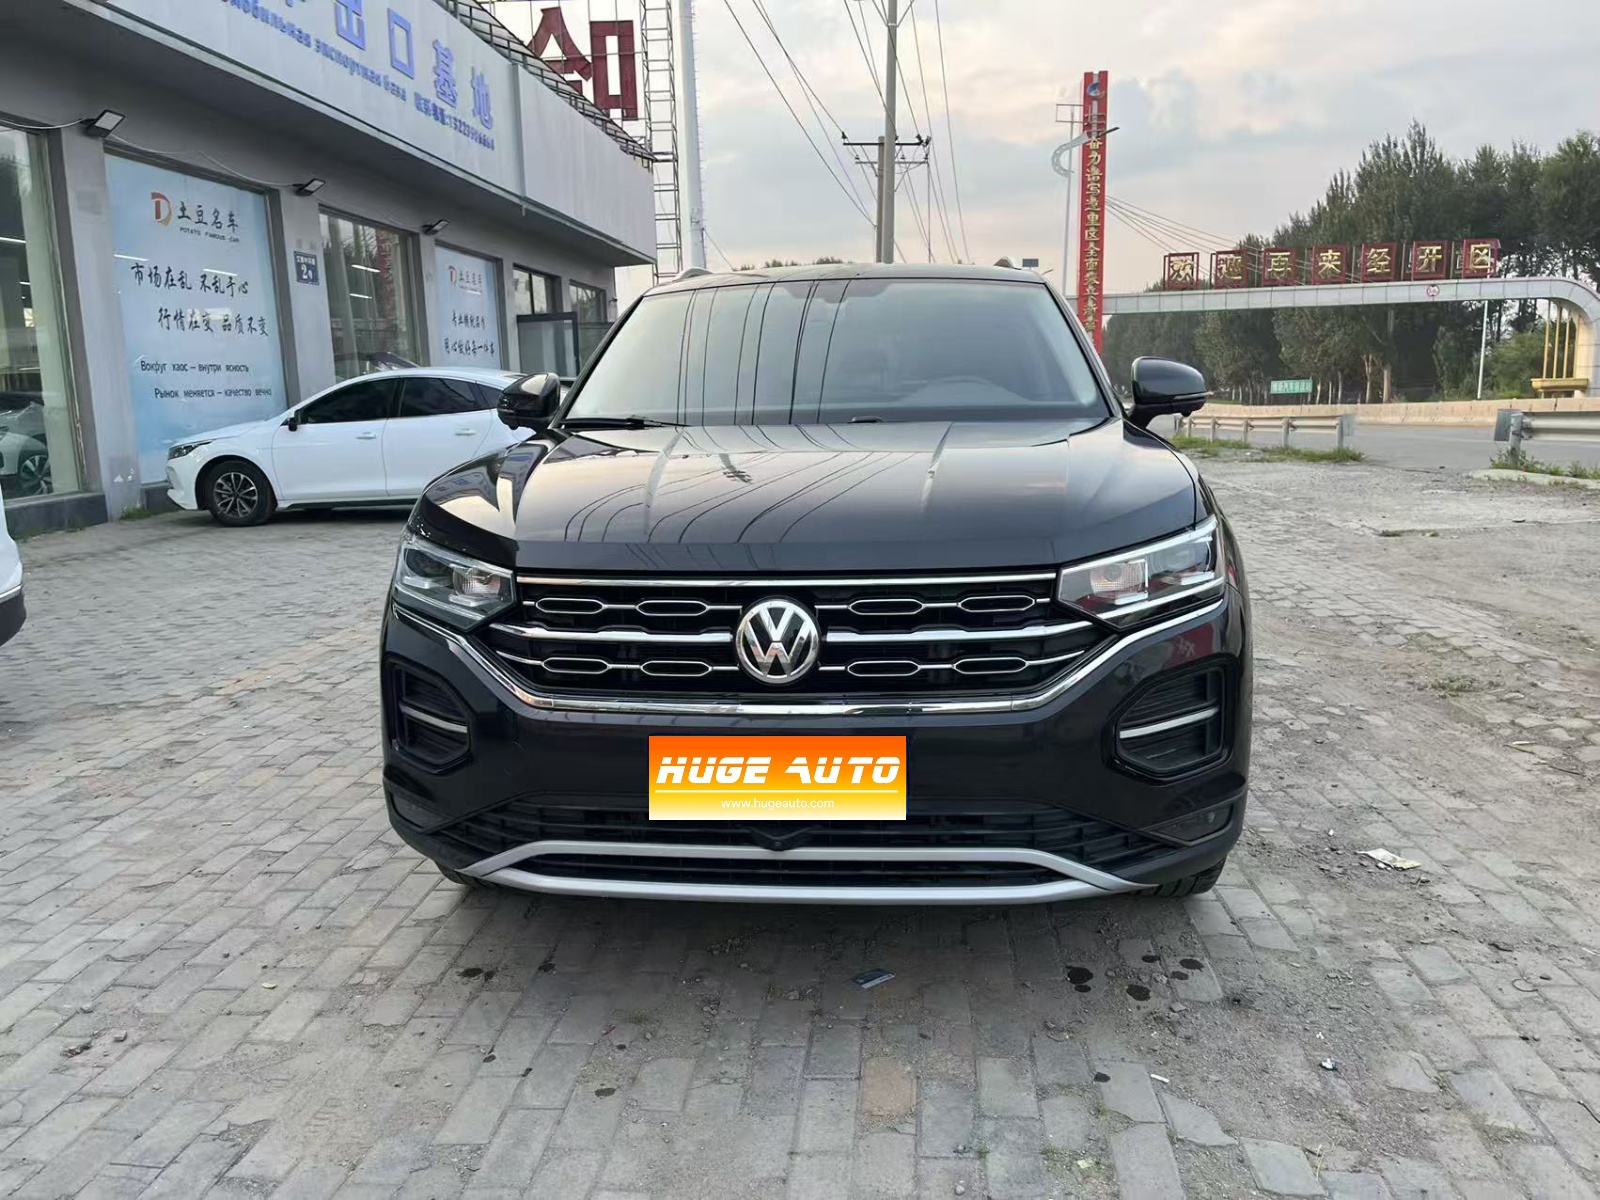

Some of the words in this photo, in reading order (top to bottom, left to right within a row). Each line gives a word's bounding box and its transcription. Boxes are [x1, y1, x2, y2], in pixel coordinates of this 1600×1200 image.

[285, 0, 494, 130] 出口基地
[177, 201, 239, 233] 土豆名车
[130, 262, 192, 290] 市场在乱
[1169, 242, 1493, 286] 欢迎再来经开区
[157, 306, 214, 333] 行情在变
[221, 313, 270, 337] 品质不变
[140, 361, 167, 374] Вокруг
[172, 363, 188, 372] хаос
[198, 363, 222, 374] внутри
[225, 363, 250, 373] ясность
[154, 388, 180, 399] Рынок
[183, 389, 215, 398] меняется
[224, 388, 252, 397] качество
[255, 387, 272, 396] вечно
